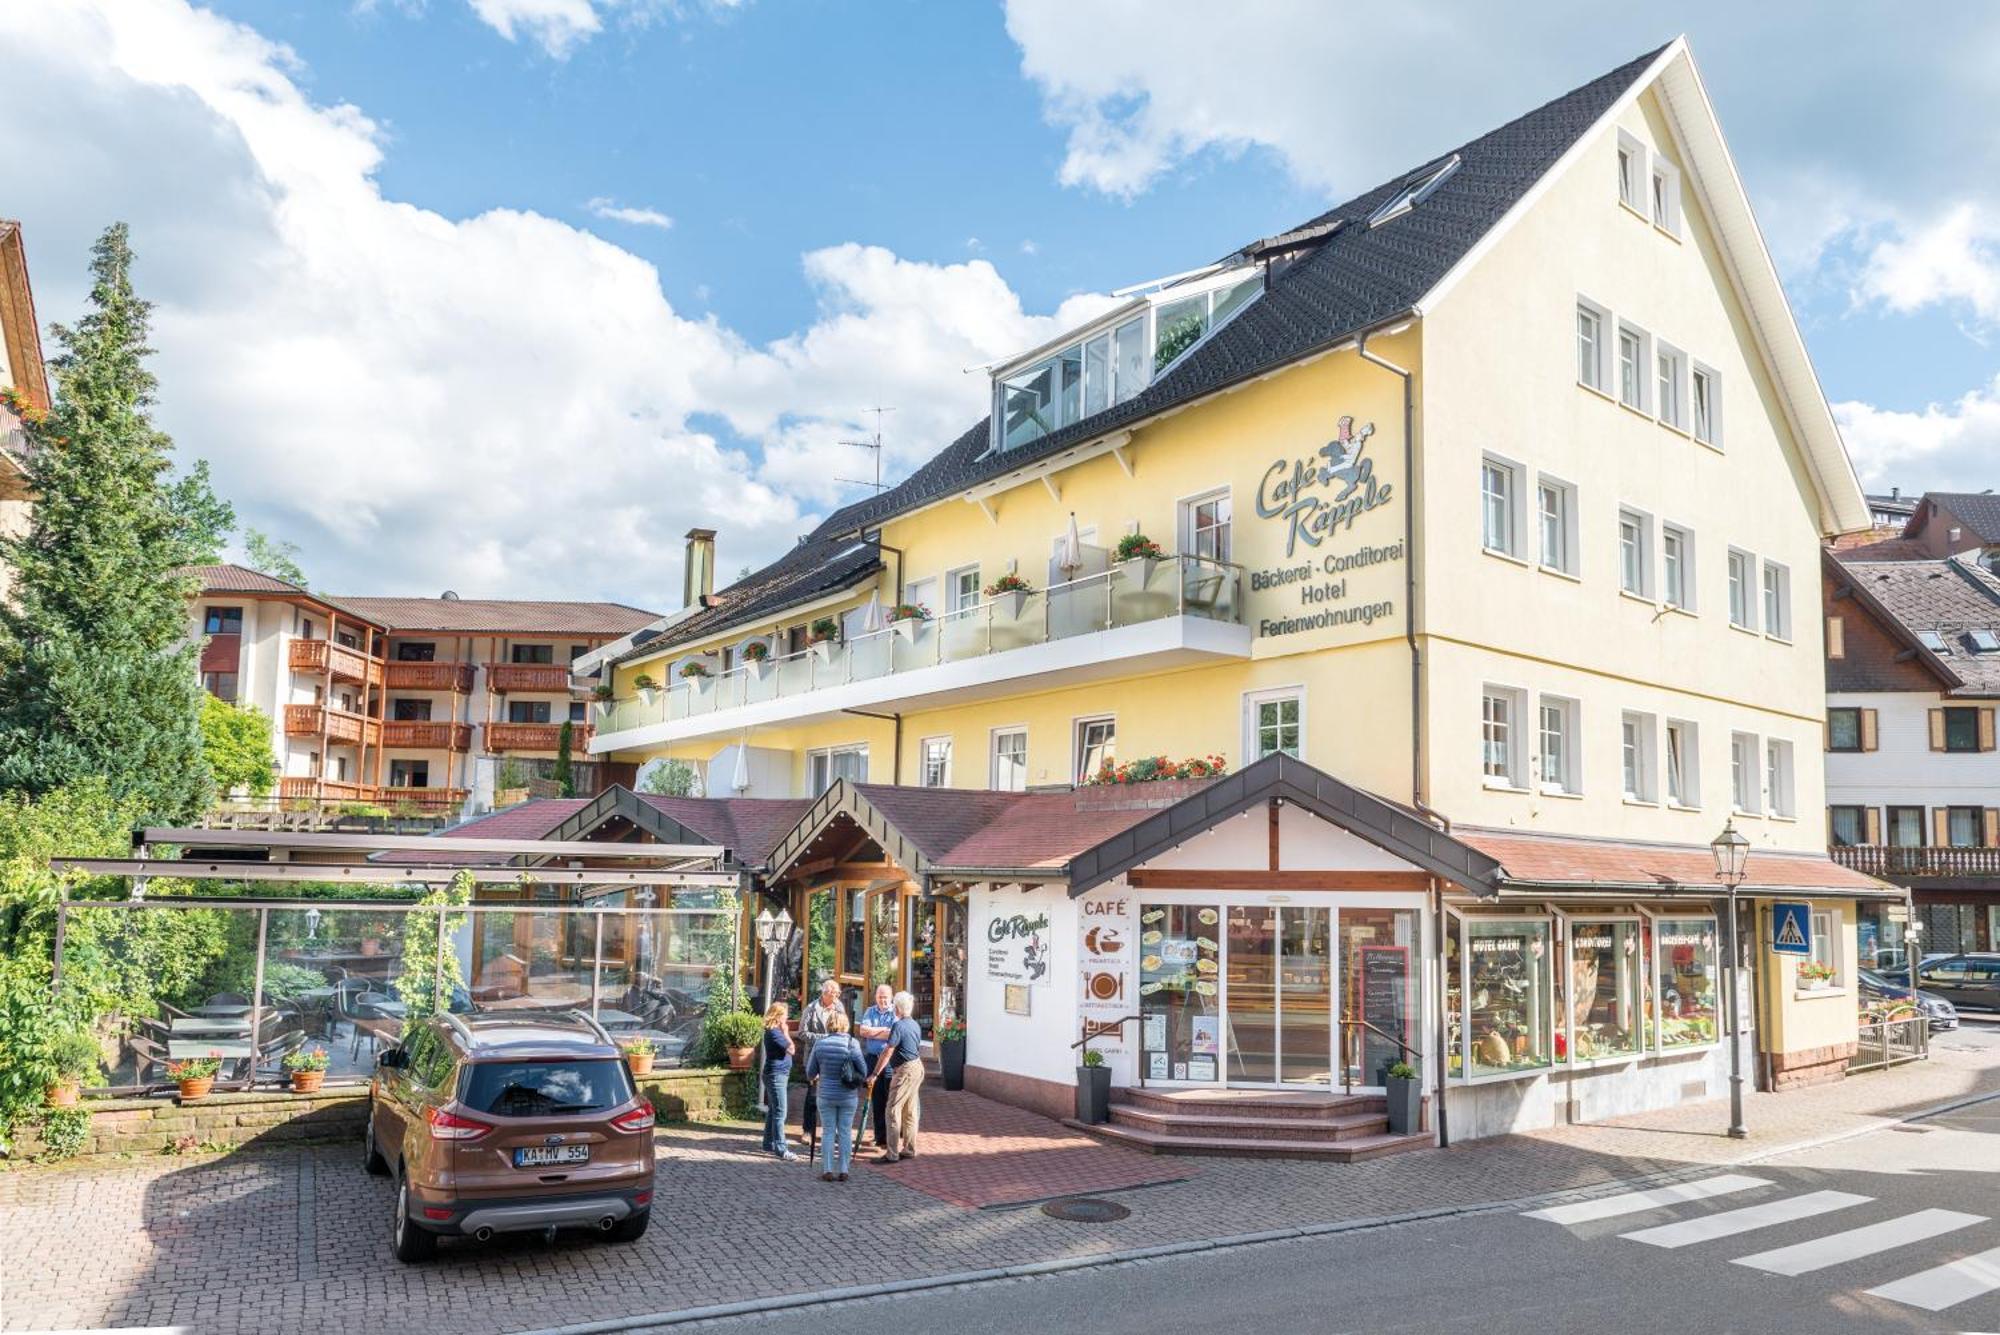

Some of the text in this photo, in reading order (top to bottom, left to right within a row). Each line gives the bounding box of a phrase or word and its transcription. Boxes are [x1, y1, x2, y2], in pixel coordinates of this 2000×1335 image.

[1256, 457, 1316, 519] Café
[1282, 475, 1392, 557] Räpple
[1251, 538, 1404, 591] Bäckerei Conditorei
[1301, 578, 1347, 605] Hotel
[1260, 600, 1393, 638] Ferienwohnungen
[1084, 899, 1126, 916] CAFÉ
[523, 1148, 537, 1161] KA
[568, 1145, 588, 1159] 554
